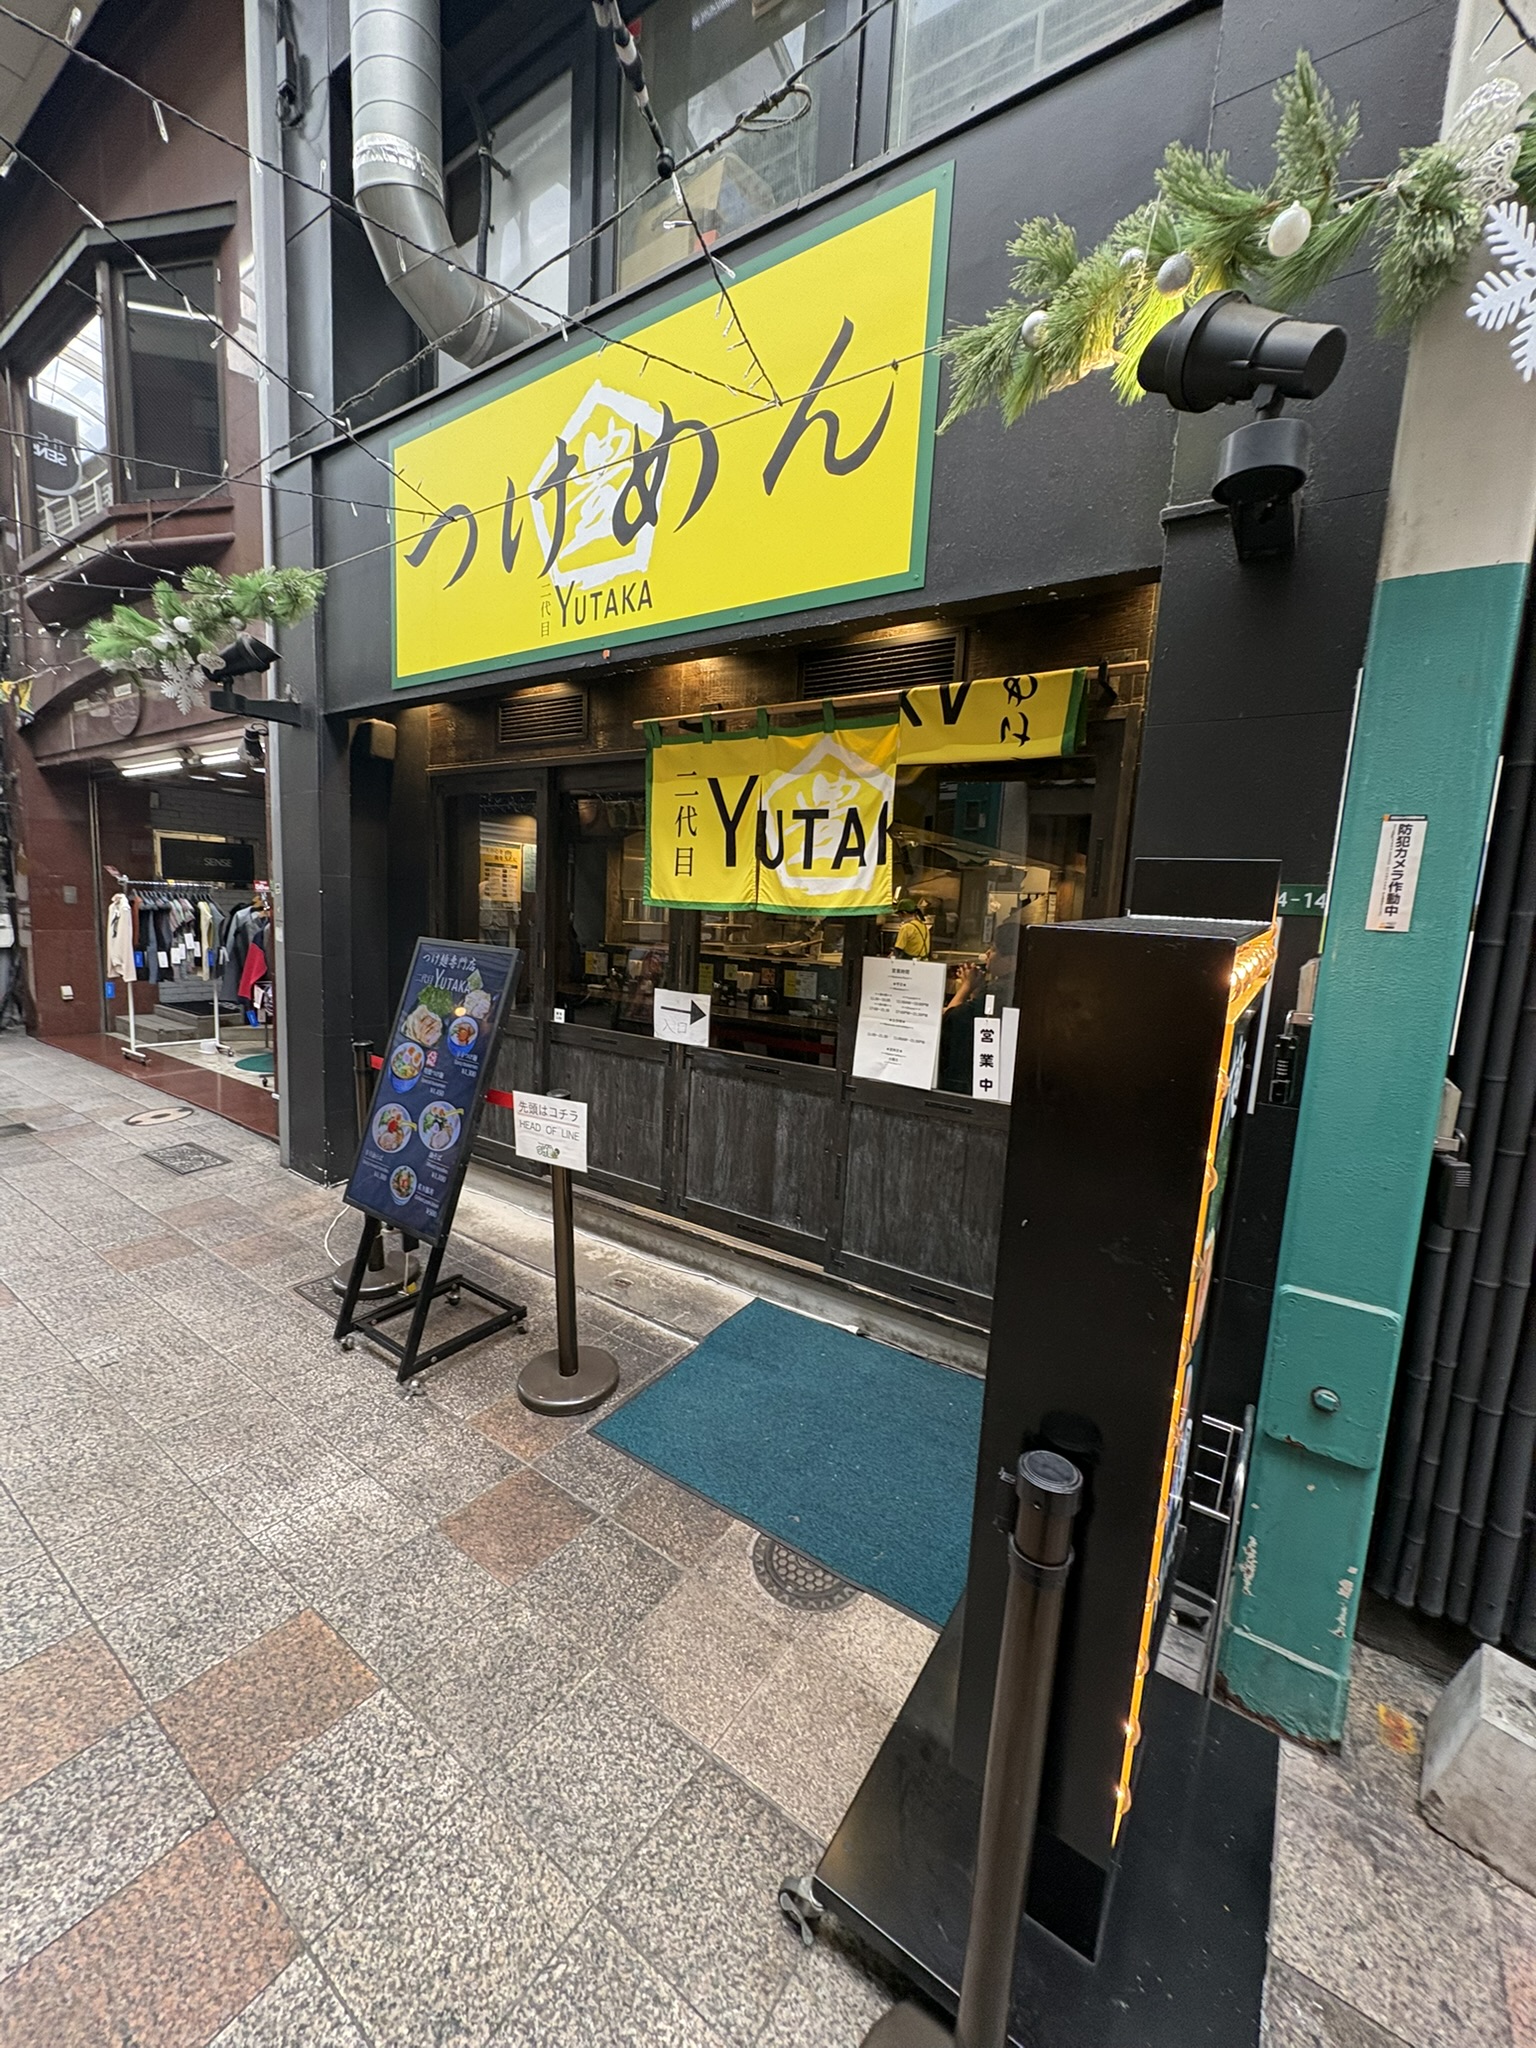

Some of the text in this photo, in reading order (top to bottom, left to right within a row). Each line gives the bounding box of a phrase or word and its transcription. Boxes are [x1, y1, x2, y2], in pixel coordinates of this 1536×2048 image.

[404, 315, 895, 591] つけめん
[540, 583, 551, 637] 二代目
[554, 579, 653, 628] YUTAKA
[674, 771, 699, 877] 二代目
[203, 857, 233, 868] SENSE
[1384, 823, 1414, 917] 防犯カメラ作動中
[662, 1018, 688, 1035] 入口
[979, 1028, 995, 1092] 営業中
[518, 1100, 579, 1122] 先頭はコチラ
[518, 1119, 581, 1142] HEAD OF LINE
